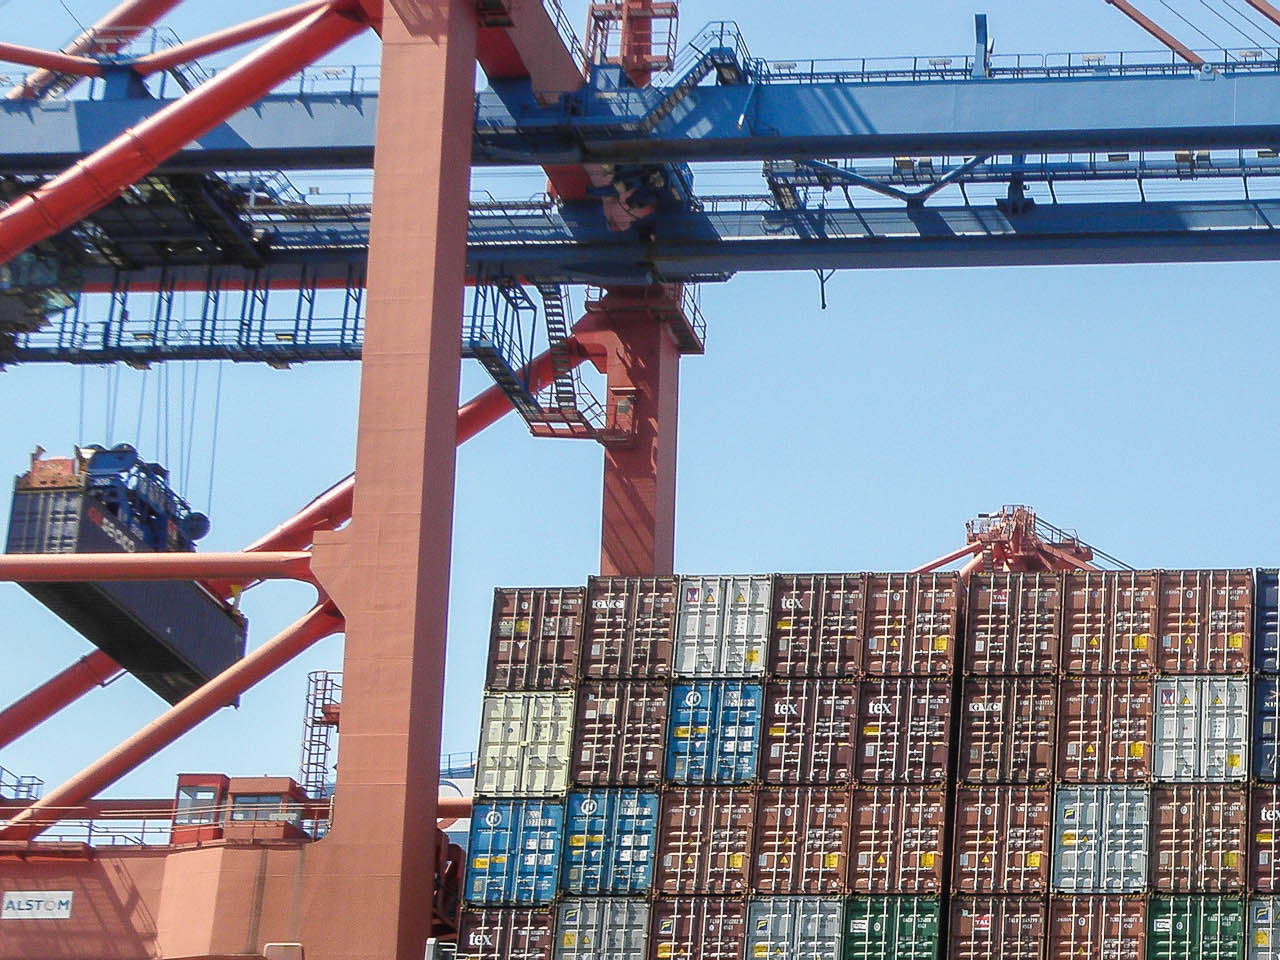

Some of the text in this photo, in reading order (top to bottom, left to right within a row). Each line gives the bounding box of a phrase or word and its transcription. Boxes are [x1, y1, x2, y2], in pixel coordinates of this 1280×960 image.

[780, 595, 804, 609] tex
[774, 701, 798, 715] tex
[868, 701, 892, 715] tex
[5, 899, 70, 911] ALSTOM
[468, 930, 493, 946] tex
